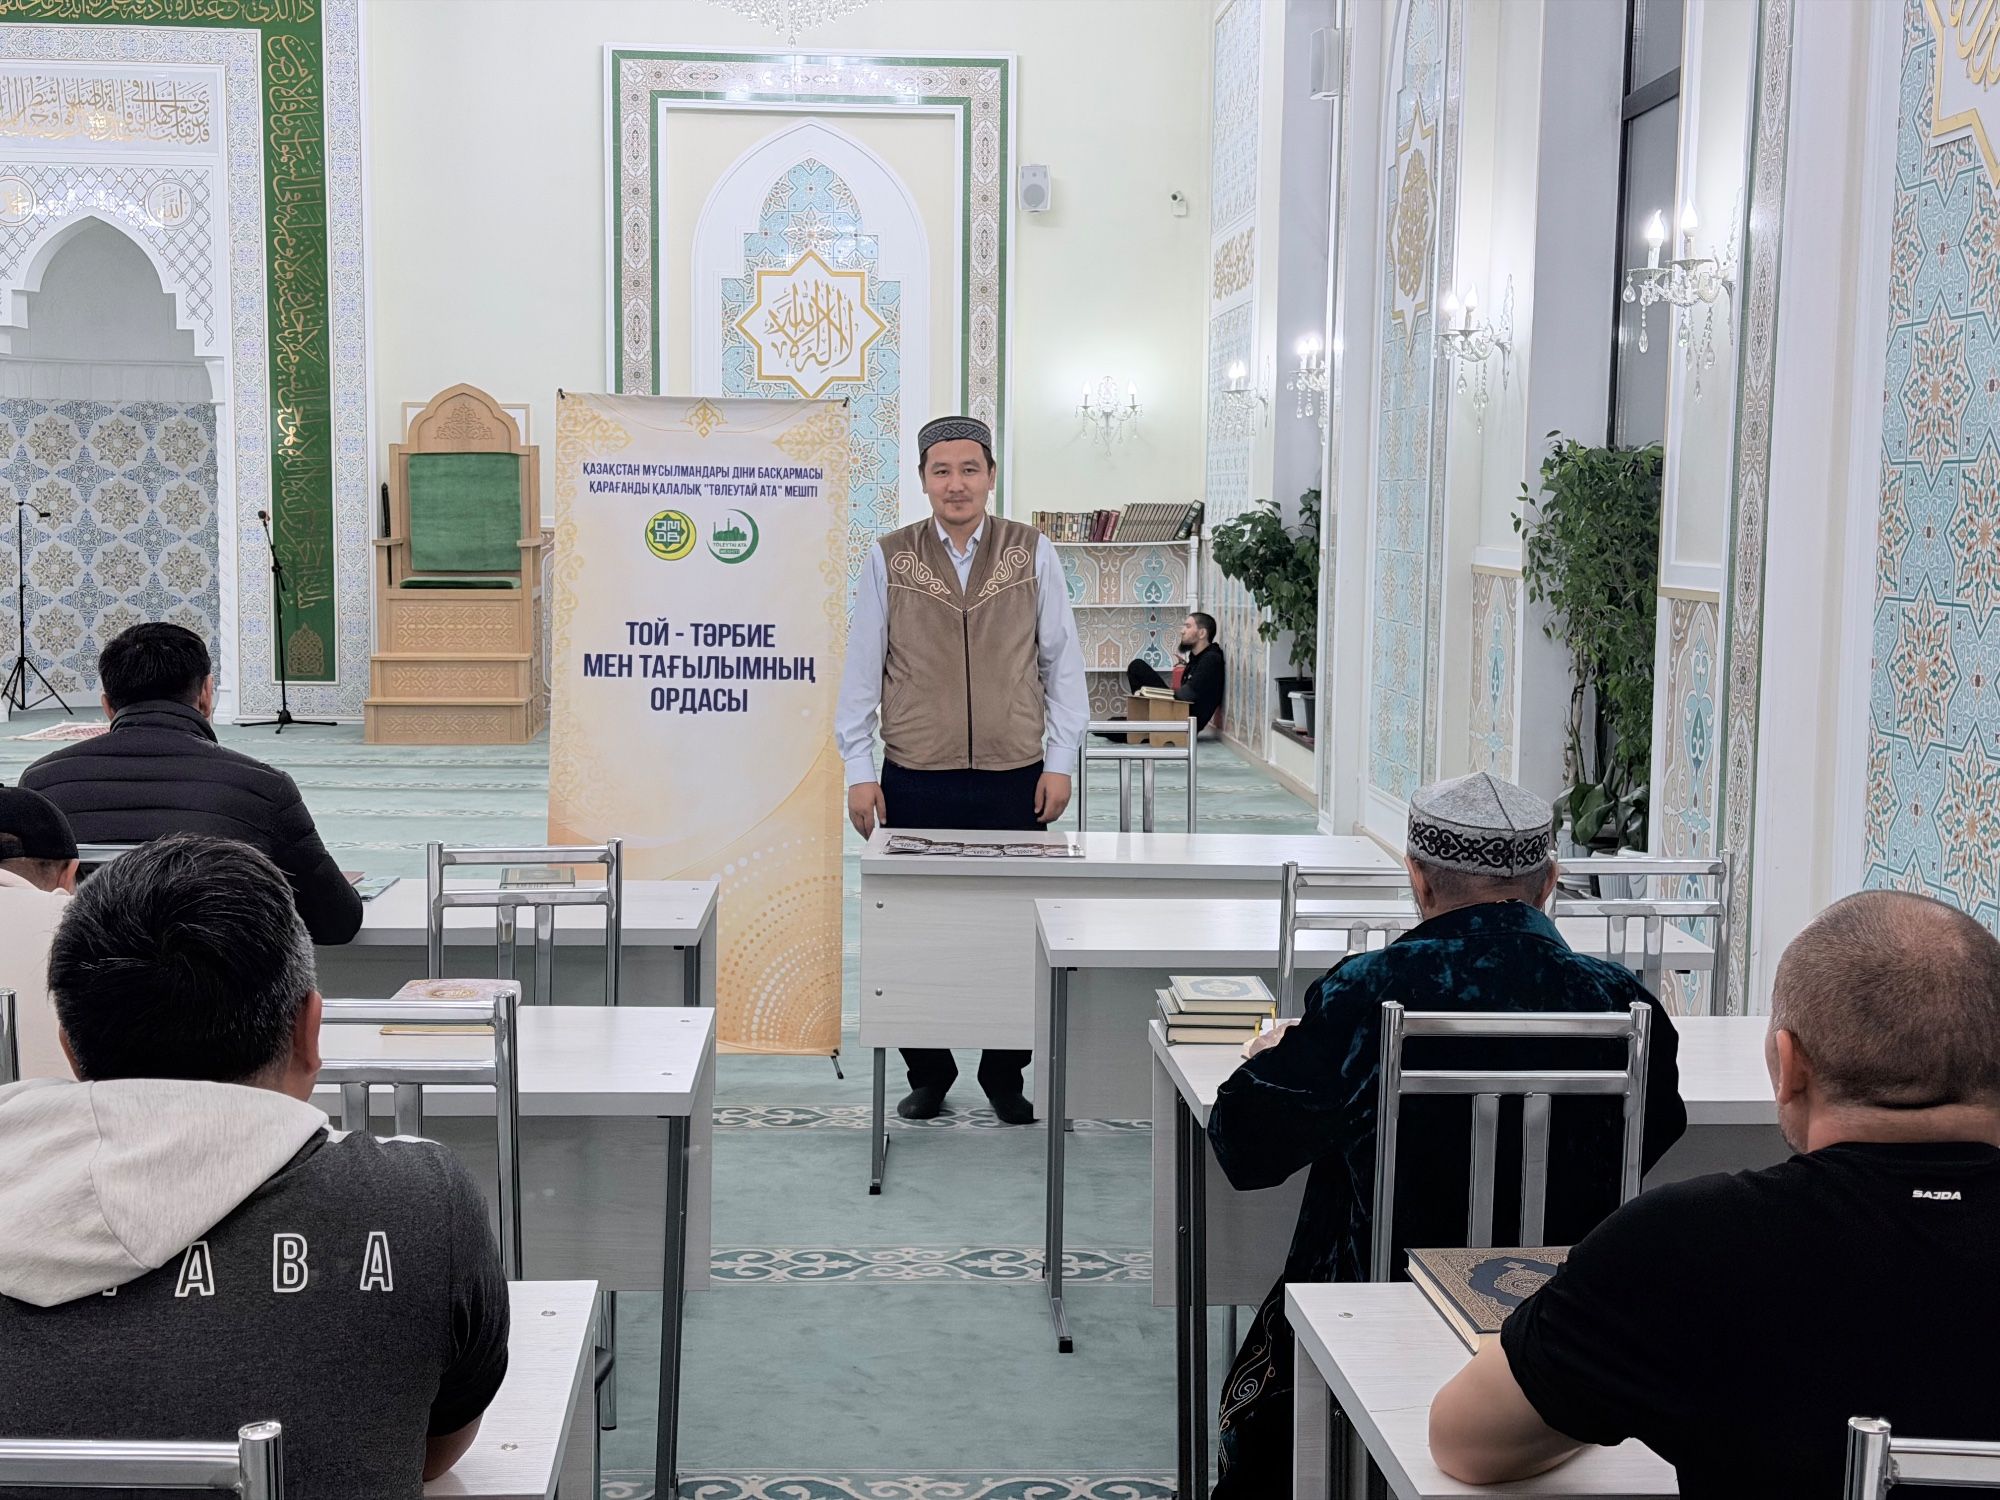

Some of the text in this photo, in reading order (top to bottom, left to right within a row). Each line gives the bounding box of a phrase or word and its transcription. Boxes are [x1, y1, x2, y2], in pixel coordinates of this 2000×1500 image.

[583, 462, 823, 480] ҚАЗАҚСТАН МҰСЫЛМАНДАРЫ ДІНИ БАСҚАРМАСЫ
[589, 480, 818, 498] ҚАРАҒАНДЫ ҚАЛАЛЫҚ "ТӨЛЕУТАЙ АТА" МЕШІТІ
[626, 617, 670, 647] ТОЙ
[690, 622, 776, 648] ТӘРБИЕ
[583, 653, 816, 684] МЕН ТАҒЫЛЫМНЫҢ
[650, 686, 748, 714] ОРДАСЫ
[1912, 1189, 1962, 1201] SAJDA
[102, 1231, 394, 1298] ABA
